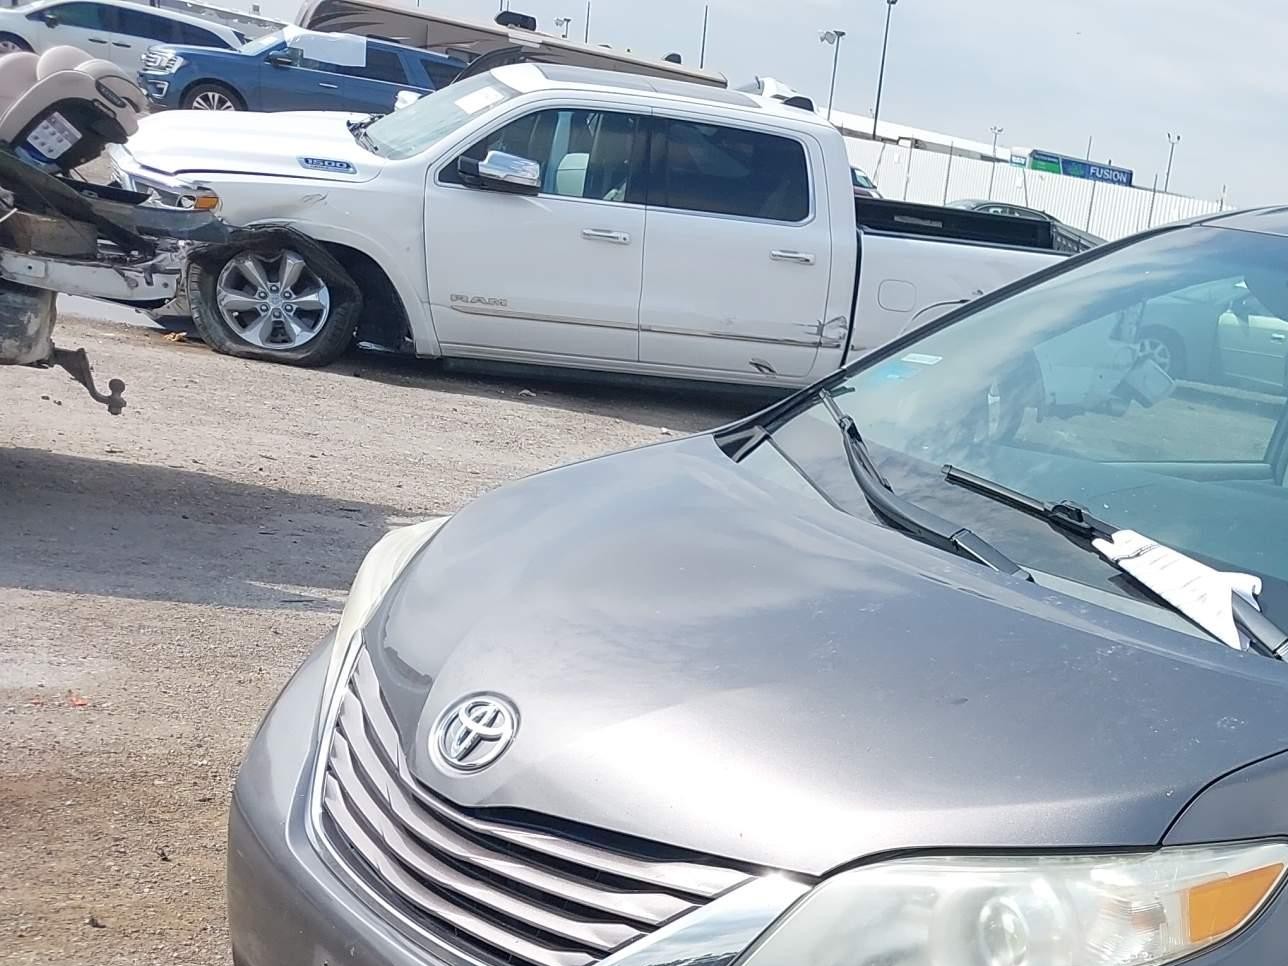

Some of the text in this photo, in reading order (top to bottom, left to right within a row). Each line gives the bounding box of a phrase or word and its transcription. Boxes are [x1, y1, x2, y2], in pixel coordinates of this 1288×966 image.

[305, 158, 348, 169] 1500
[1089, 166, 1128, 183] FUSION
[450, 294, 508, 306] RAM
